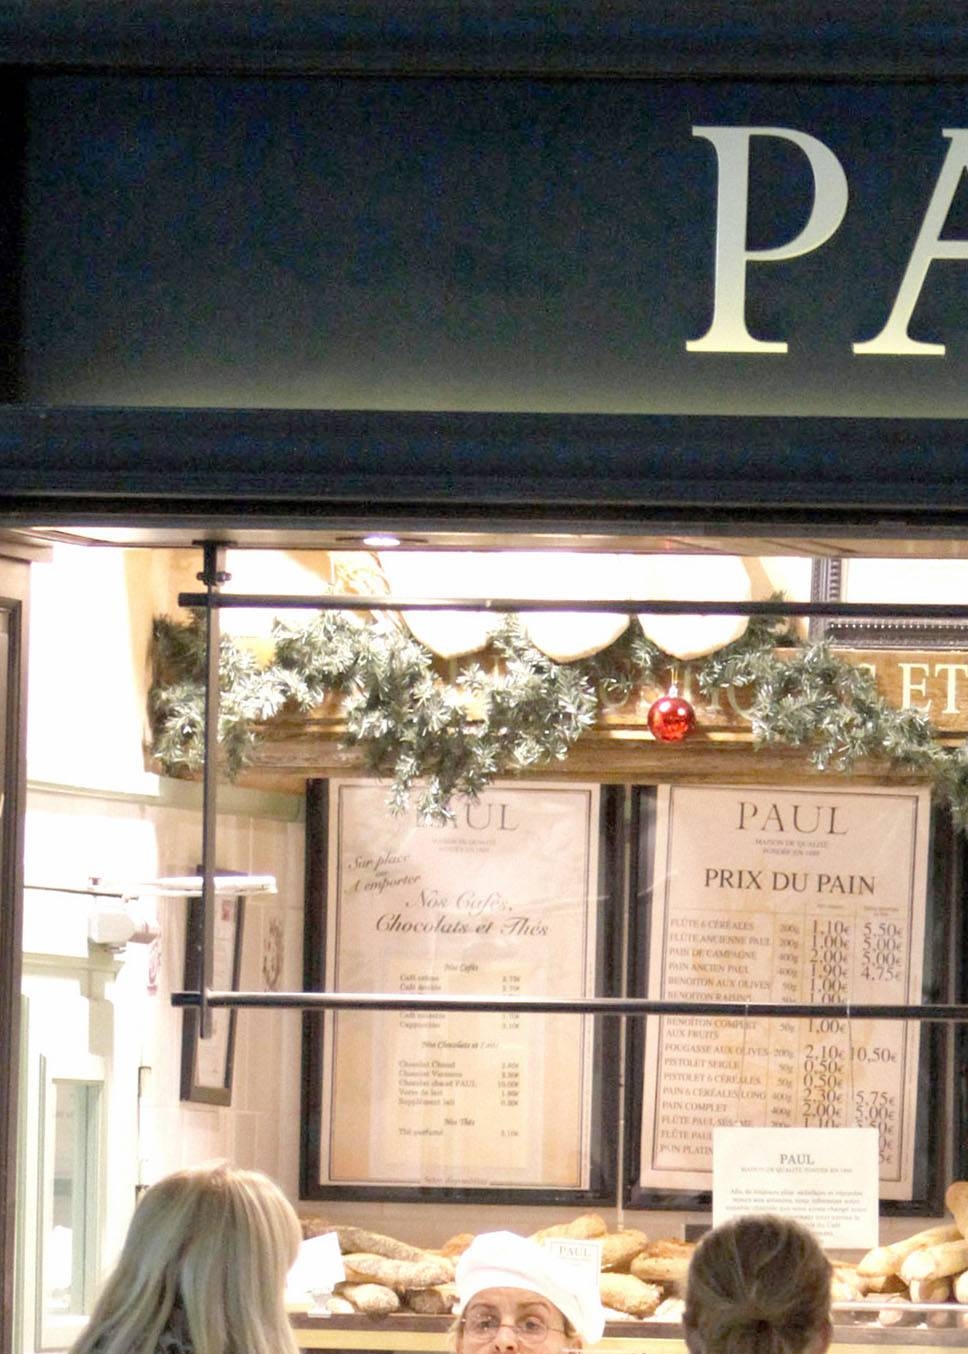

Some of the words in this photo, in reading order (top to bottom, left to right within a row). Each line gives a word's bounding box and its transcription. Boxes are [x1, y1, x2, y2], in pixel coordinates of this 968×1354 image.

[735, 801, 850, 835] PAUL
[704, 868, 763, 890] PRIX
[772, 872, 808, 893] DU
[816, 873, 876, 895] PAIN
[376, 913, 470, 934] Chocolats
[475, 920, 495, 934] et
[500, 916, 550, 936] Thés
[780, 1154, 815, 1165] PAUL
